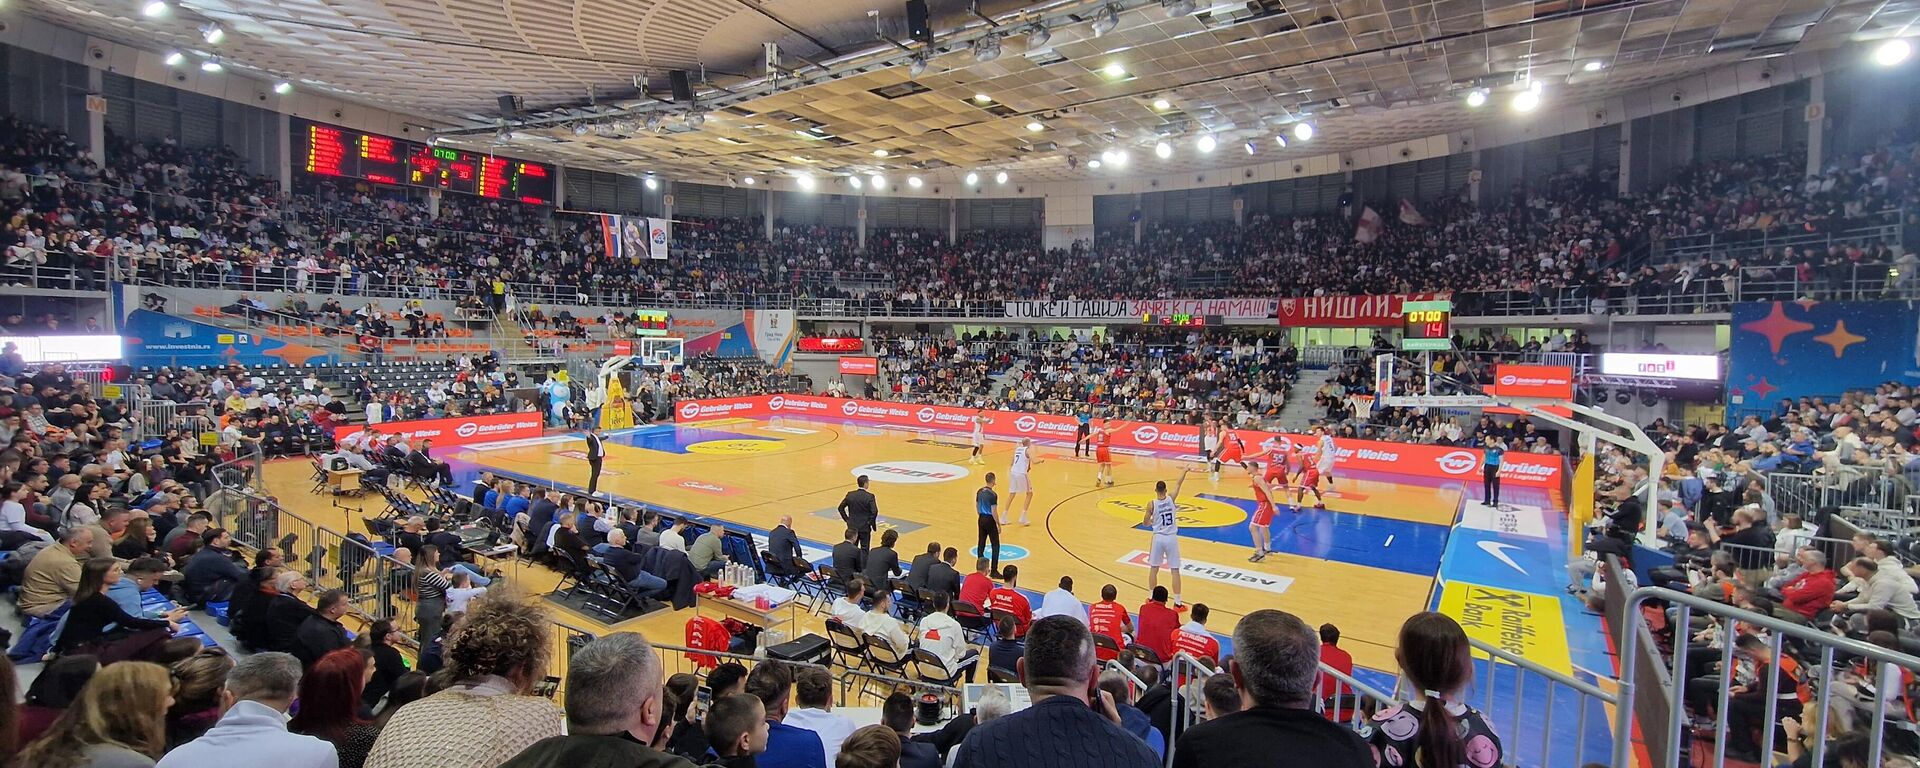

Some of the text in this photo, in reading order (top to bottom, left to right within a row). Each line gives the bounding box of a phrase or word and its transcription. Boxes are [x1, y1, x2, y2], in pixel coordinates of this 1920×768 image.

[1004, 300, 1058, 318] СТОШКЕ
[1060, 301, 1069, 318] И
[1072, 300, 1128, 318] ТАДИЈА
[1426, 323, 1443, 337] 14
[700, 402, 753, 413] Gebrüder Weiss
[858, 405, 889, 415] Gebrüder
[889, 408, 909, 417] Weiss
[935, 412, 971, 423] Gebrüder
[479, 420, 538, 433] Gebrüder Weiss
[1037, 420, 1079, 433] Gebrüder
[1014, 454, 1020, 465] 7
[1272, 453, 1285, 463] 55
[1357, 448, 1399, 462] Weiss
[1160, 512, 1173, 527] 13
[1183, 564, 1278, 586] triglav
[1460, 602, 1495, 629] Bank
